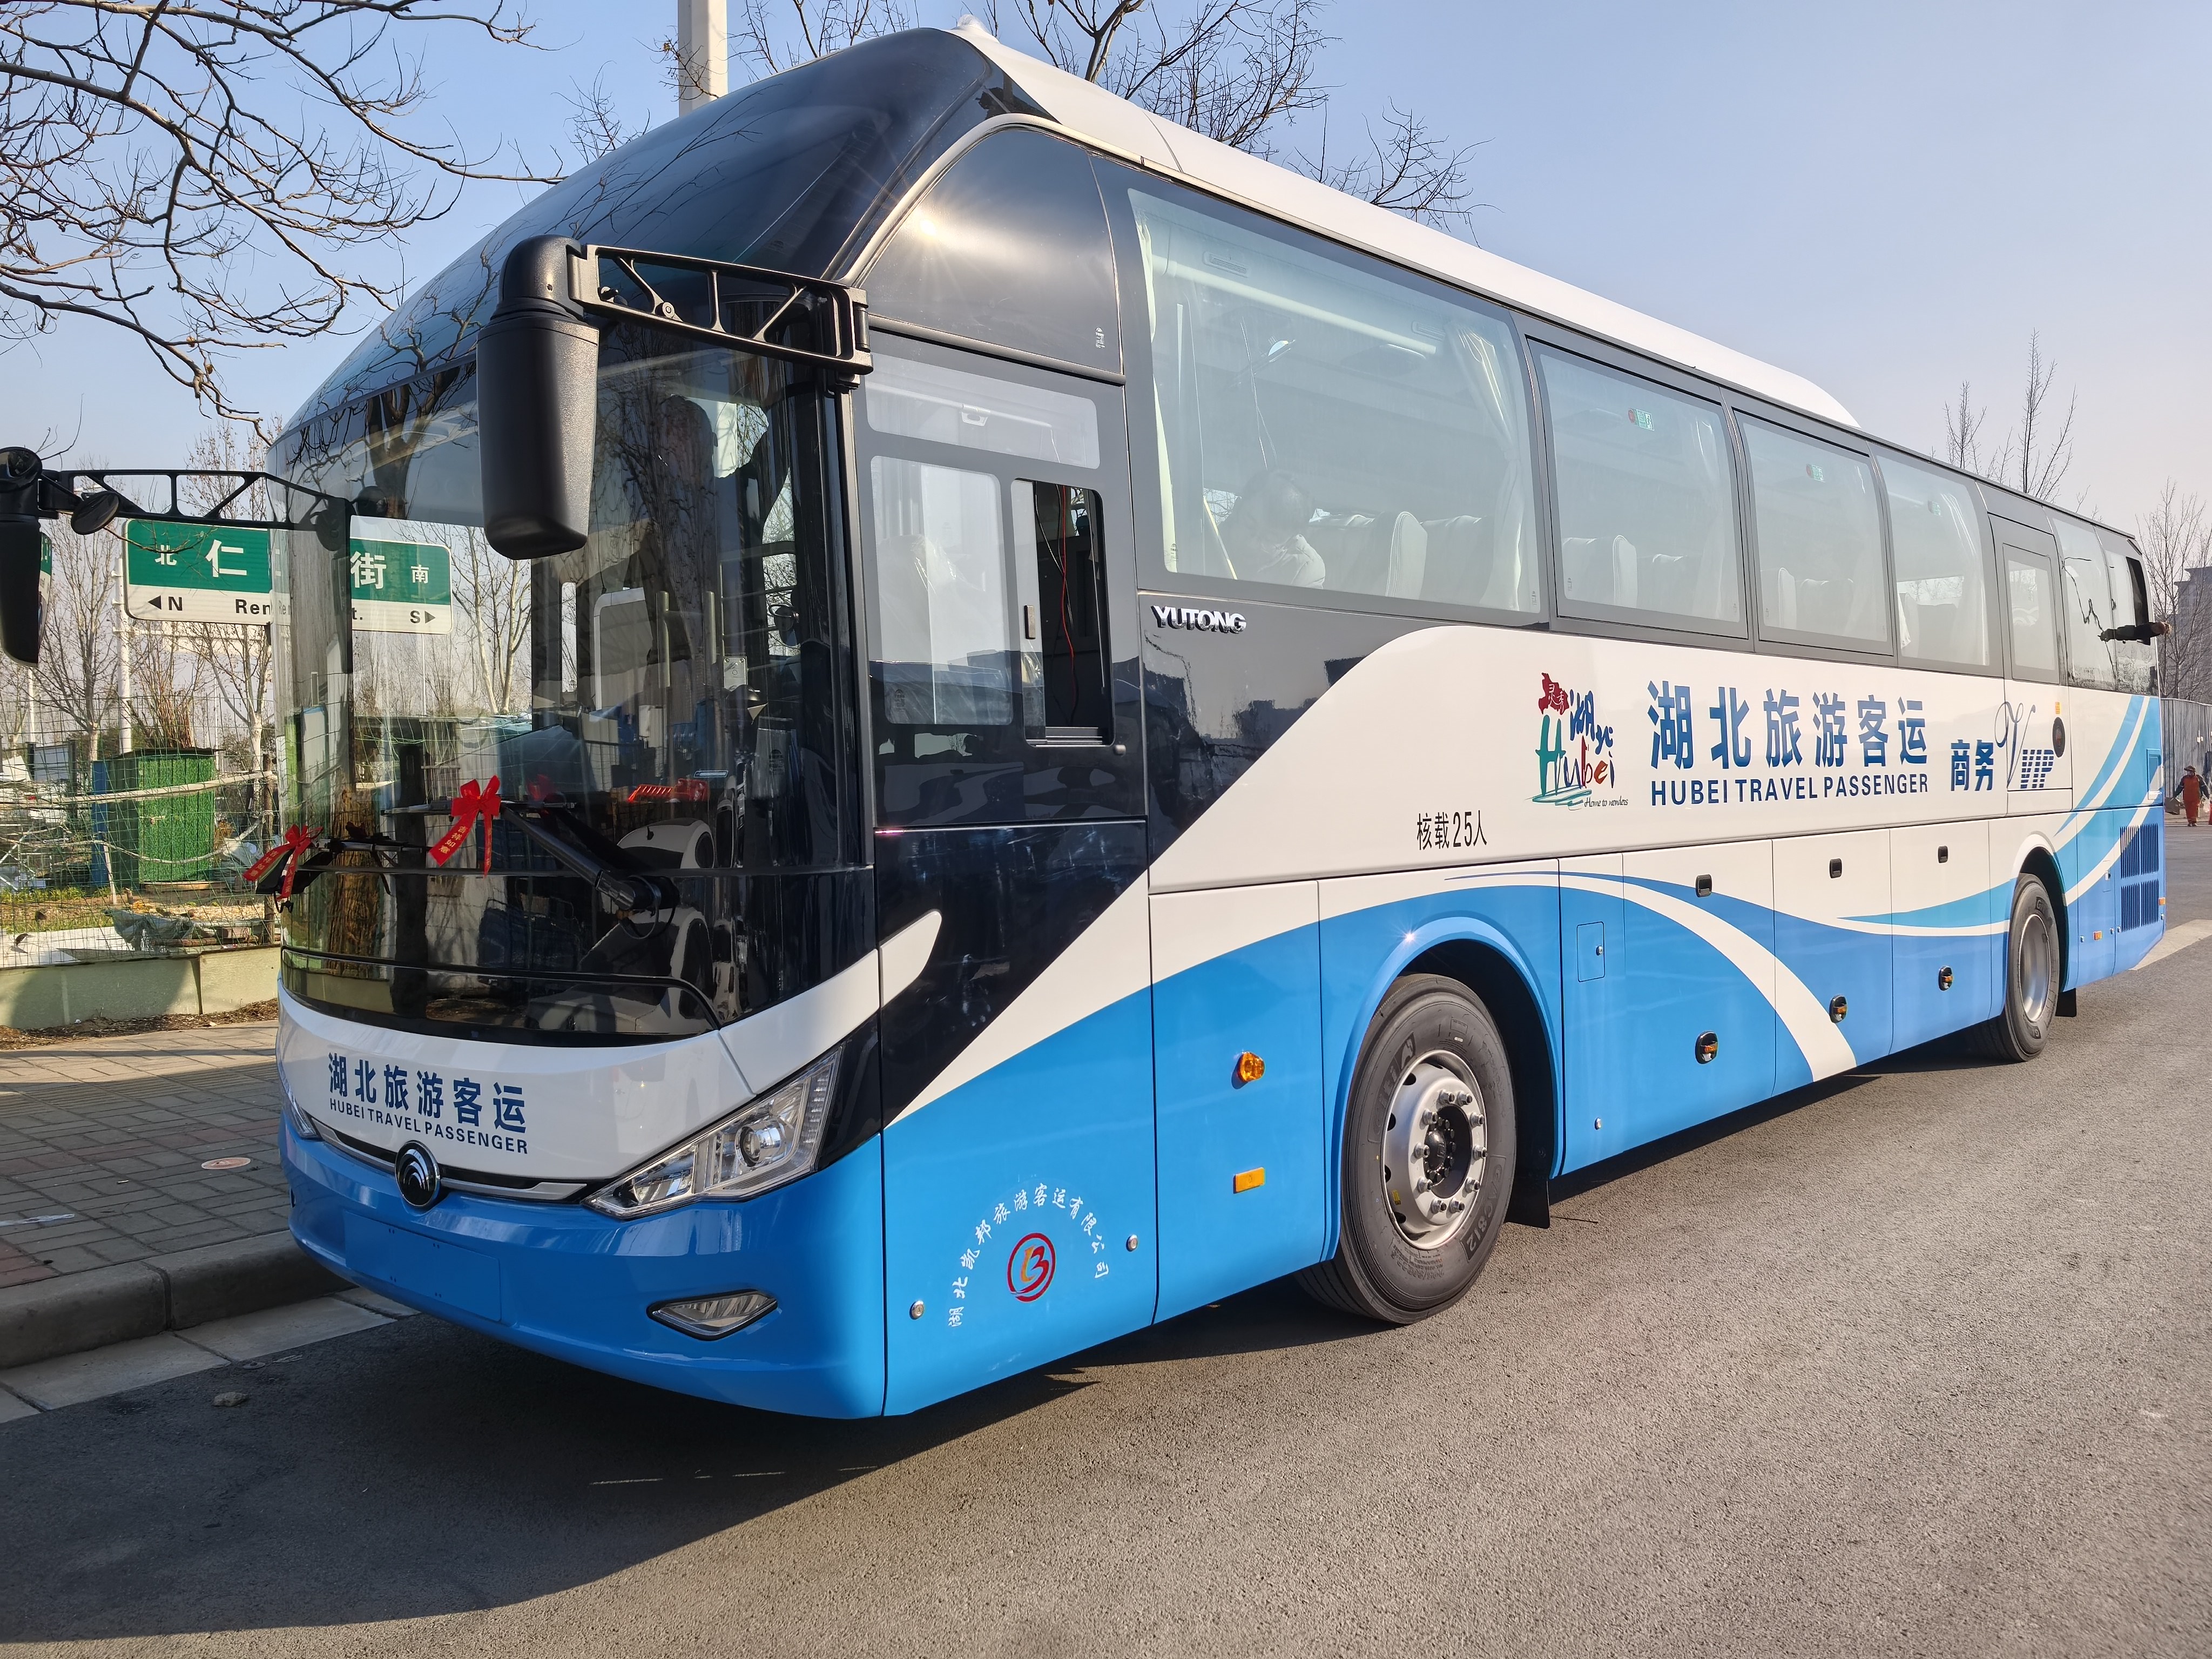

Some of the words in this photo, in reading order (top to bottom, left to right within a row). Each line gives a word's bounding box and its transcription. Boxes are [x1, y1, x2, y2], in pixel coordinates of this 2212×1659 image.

[154, 544, 177, 565] 北
[411, 564, 430, 585] 南
[168, 596, 183, 611] N
[409, 610, 421, 624] S
[1151, 605, 1247, 633] YUTONG
[1569, 689, 1614, 755] 湖北
[1647, 680, 1928, 770] 湖北旅游客运
[1535, 714, 1615, 797] Hubei
[1950, 739, 1994, 792] 商务
[1584, 797, 1601, 808] Home
[1602, 799, 1608, 807] to
[1651, 780, 1728, 806] HUBEI
[1735, 777, 1818, 802] TRAVEL
[1824, 773, 1928, 798] PASSENGER
[439, 825, 468, 854] 吉祥如意
[1417, 810, 1487, 851] 核载25人
[328, 1052, 527, 1134] 湖北旅游客运
[329, 1097, 365, 1120] HUBEI
[368, 1108, 421, 1133] TRAVEL
[425, 1121, 528, 1155] PASSENGER
[948, 1182, 1109, 1327] 湖北凯邦旅游客运有限公司
